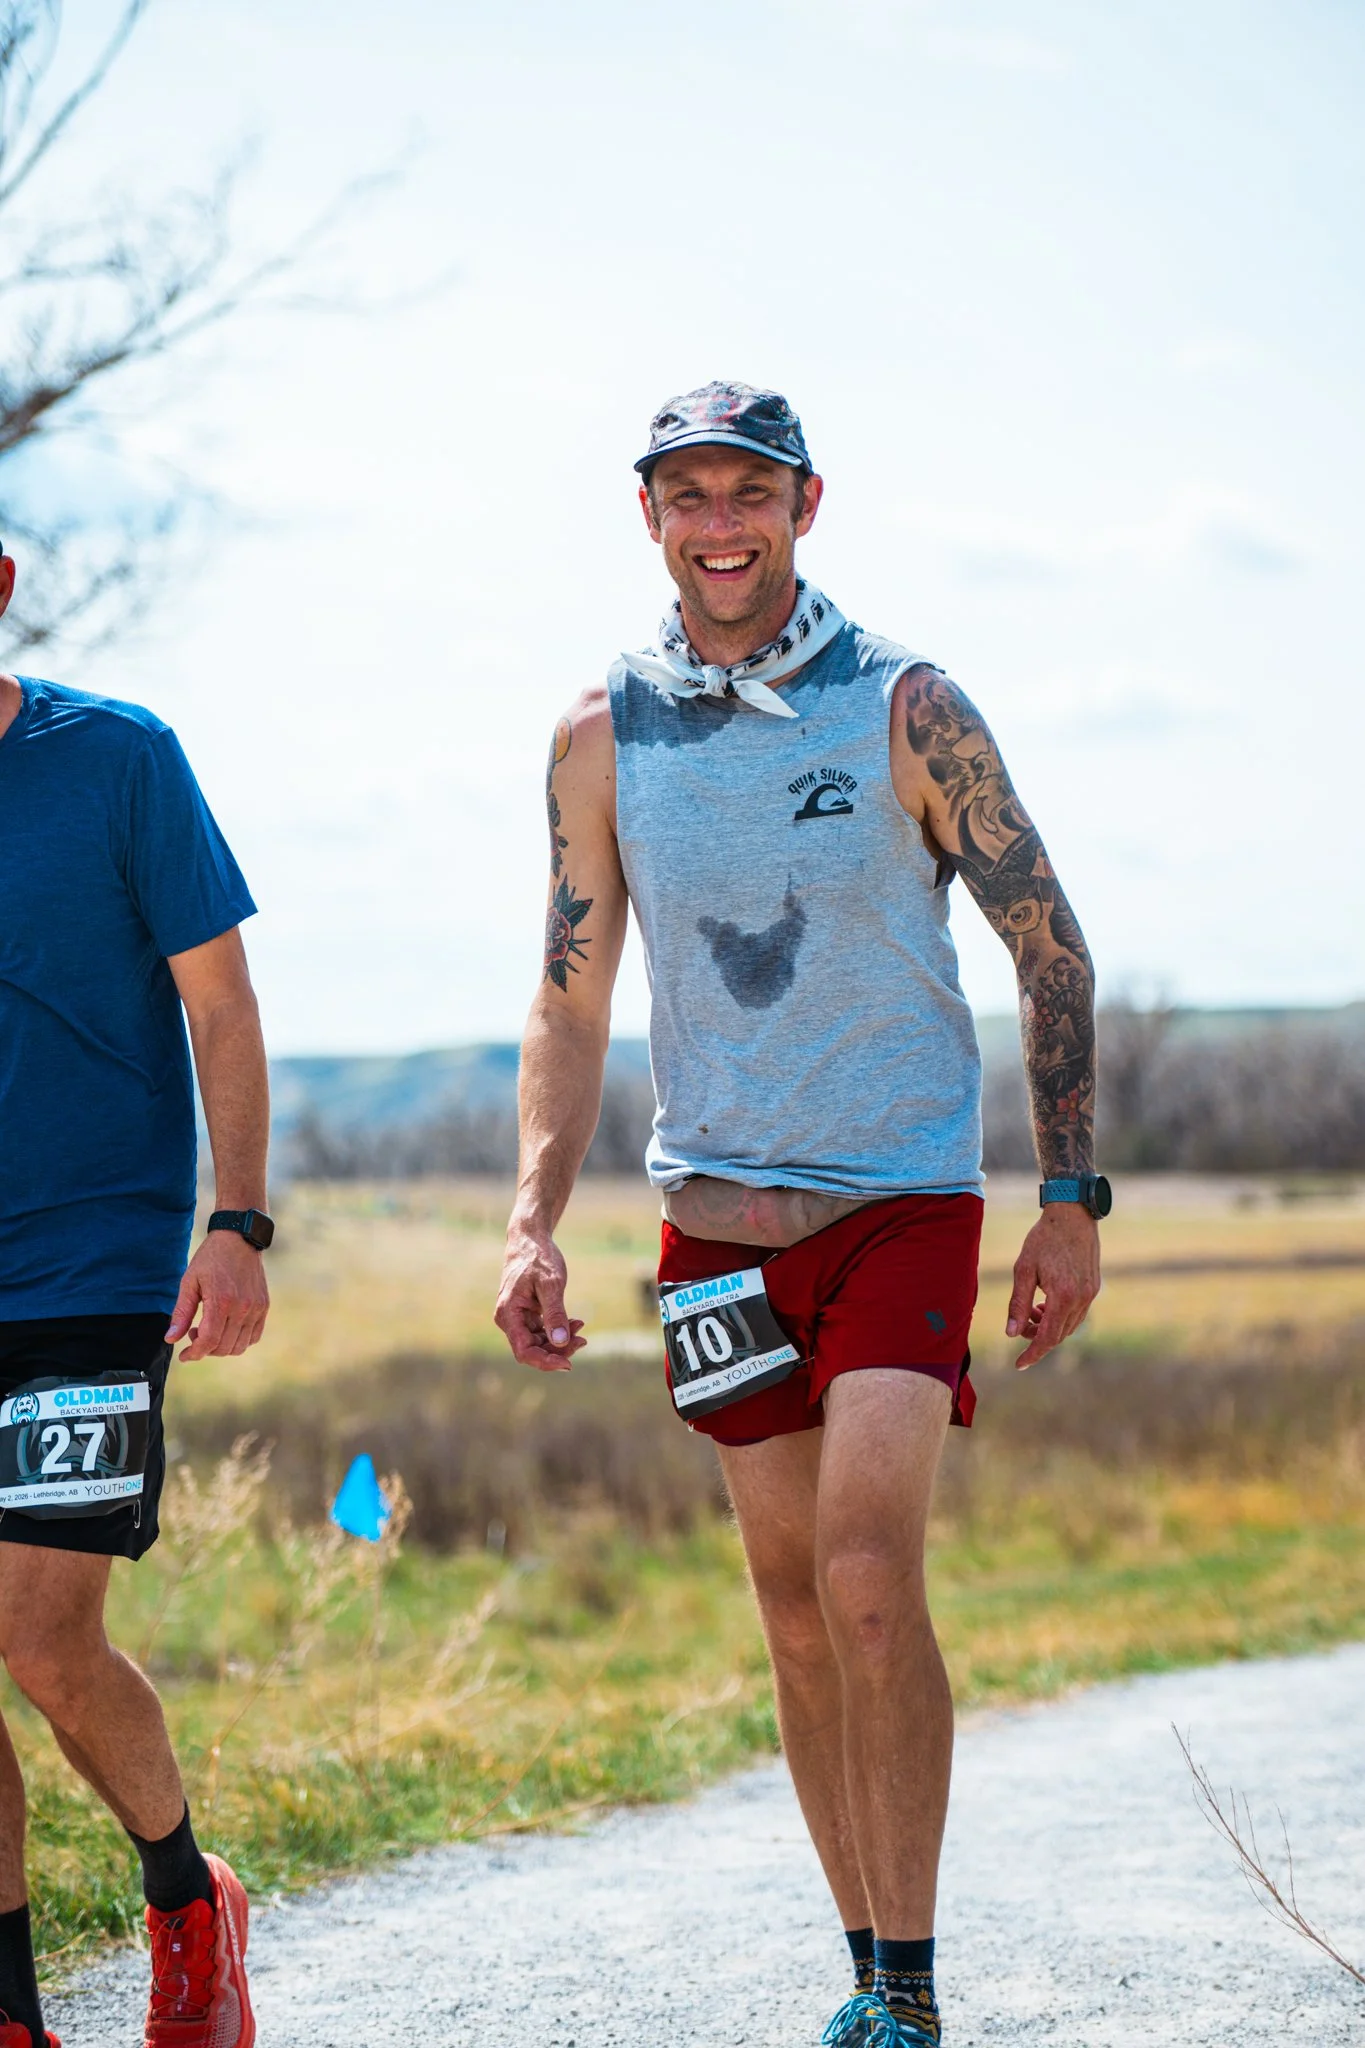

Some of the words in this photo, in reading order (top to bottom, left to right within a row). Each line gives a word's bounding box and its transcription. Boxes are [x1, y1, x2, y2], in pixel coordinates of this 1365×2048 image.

[788, 771, 817, 795] QUIK
[820, 768, 857, 795] SILVER
[674, 1273, 744, 1308] OLDMAN
[682, 1300, 715, 1316] BACKYARD
[716, 1293, 740, 1305] ULTRA
[675, 1316, 733, 1372] 10
[723, 1349, 794, 1384] YOUTHONE
[712, 1379, 721, 1387] AB
[54, 1386, 134, 1408] OLDMAN
[60, 1406, 104, 1416] BACKYARD
[107, 1404, 129, 1413] ULTRA
[41, 1422, 106, 1475] 27
[85, 1479, 142, 1496] YOUTHONE
